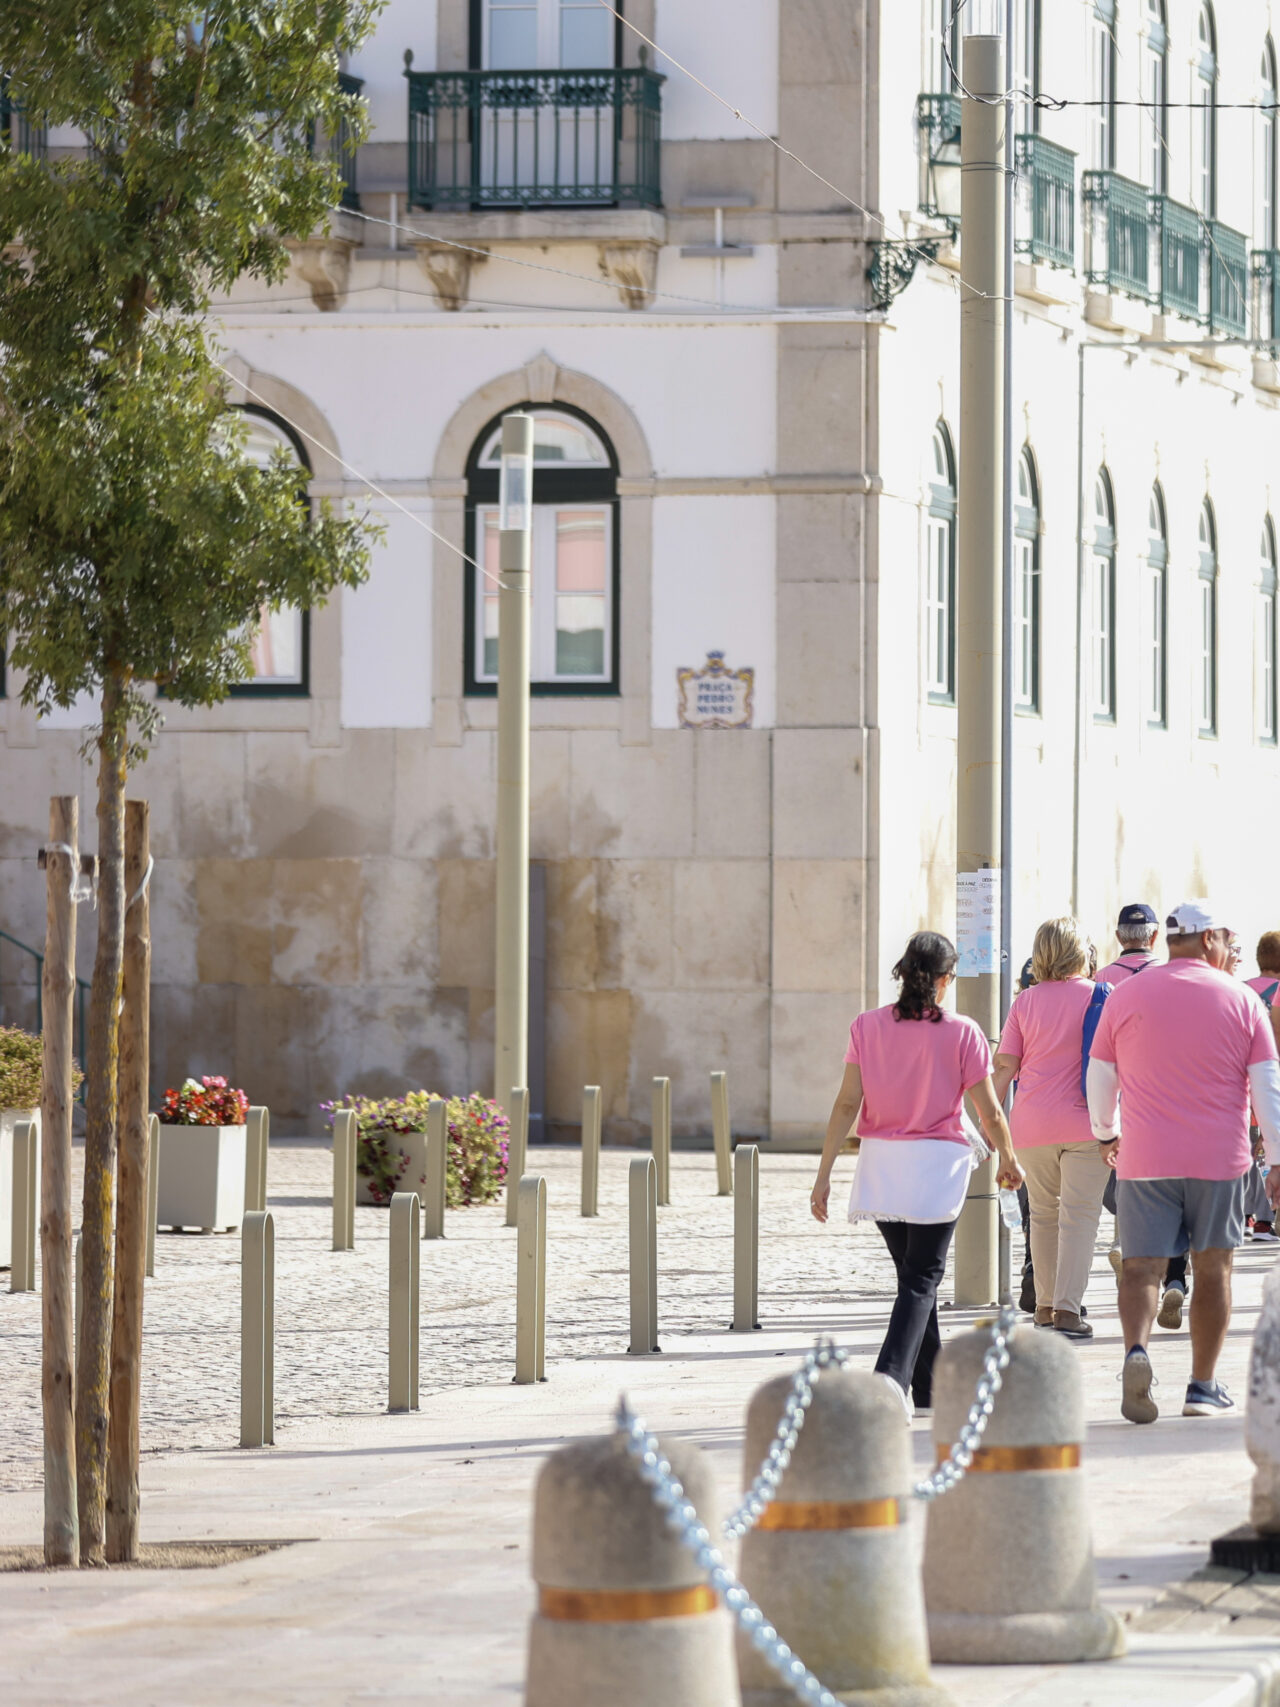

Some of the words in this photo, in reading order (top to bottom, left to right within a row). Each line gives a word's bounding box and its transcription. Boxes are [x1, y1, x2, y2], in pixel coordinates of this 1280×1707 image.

[698, 682, 732, 693] PRAÇA
[697, 694, 735, 703] PEDRO
[696, 705, 733, 714] NUNES
